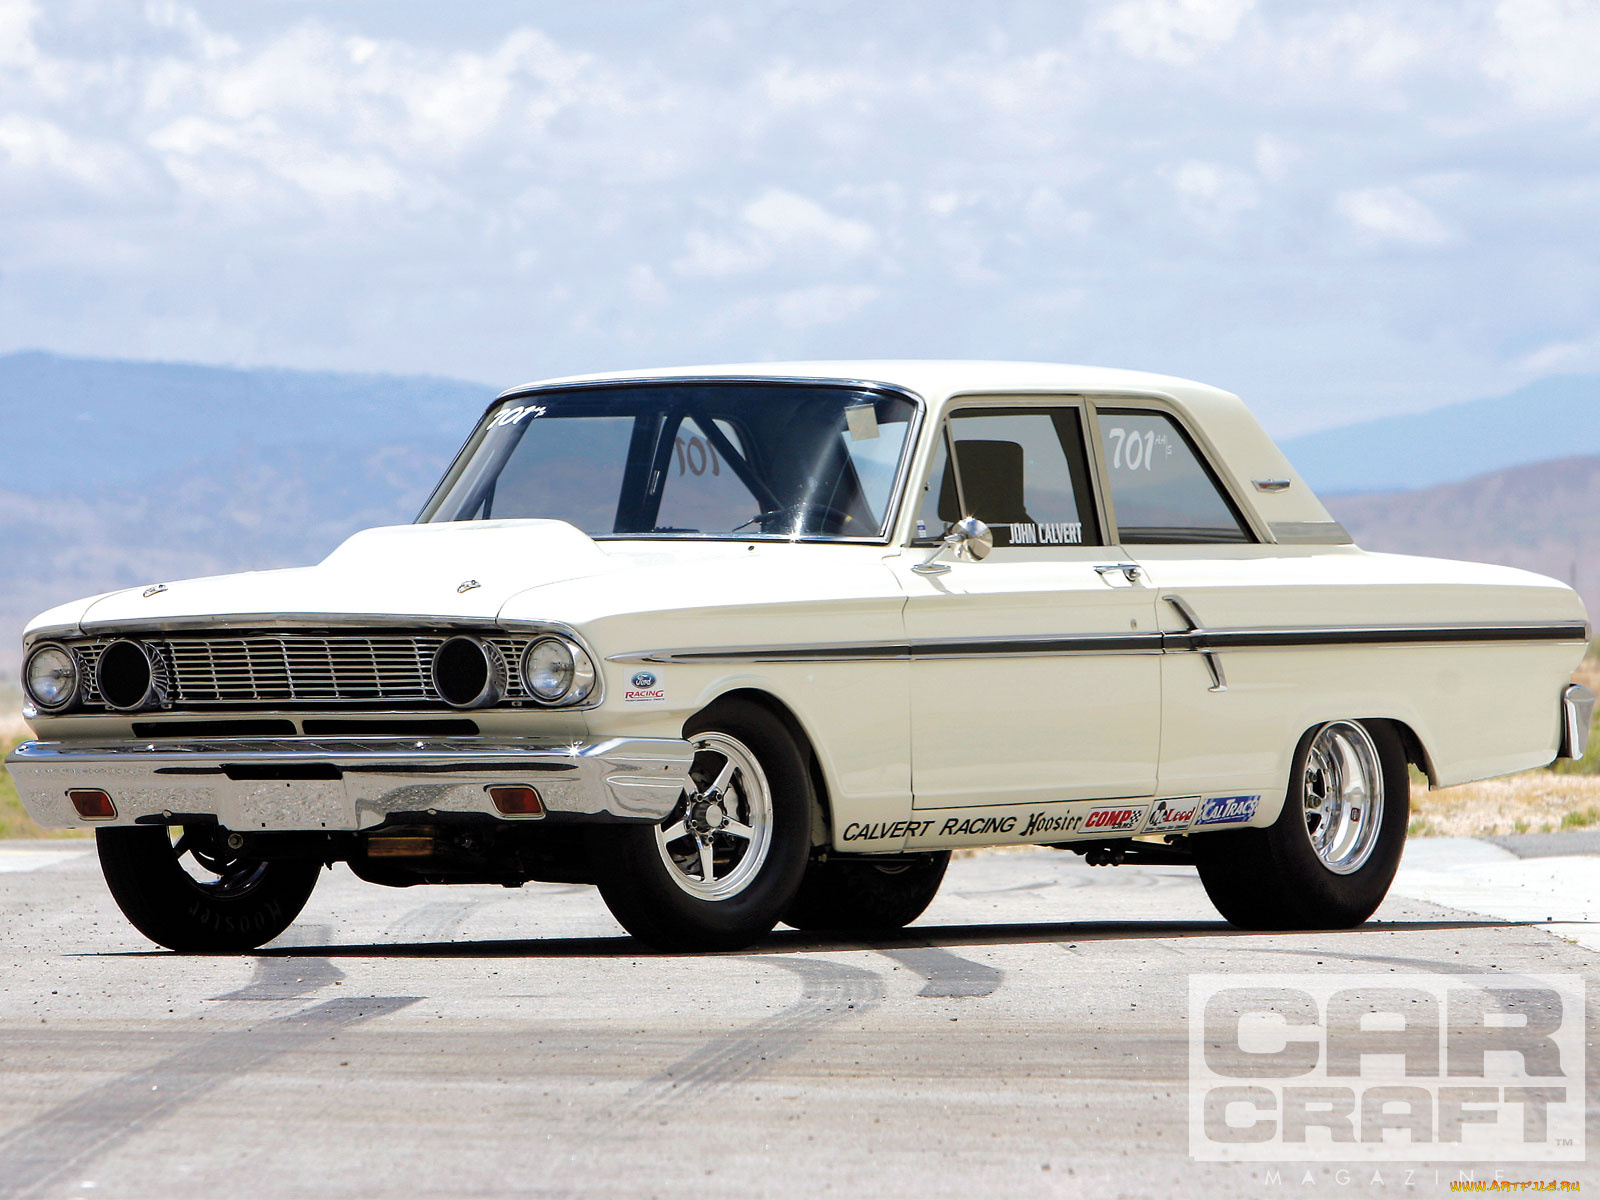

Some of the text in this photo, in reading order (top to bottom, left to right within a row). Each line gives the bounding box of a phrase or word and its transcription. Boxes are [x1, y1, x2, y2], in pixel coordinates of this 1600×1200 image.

[1109, 427, 1155, 471] 701
[1009, 523, 1082, 544] JOHN CALVERT
[635, 674, 652, 686] Ford
[625, 690, 664, 699] RACING
[843, 816, 1017, 841] CALVERT RACING
[1085, 810, 1133, 828] COMP
